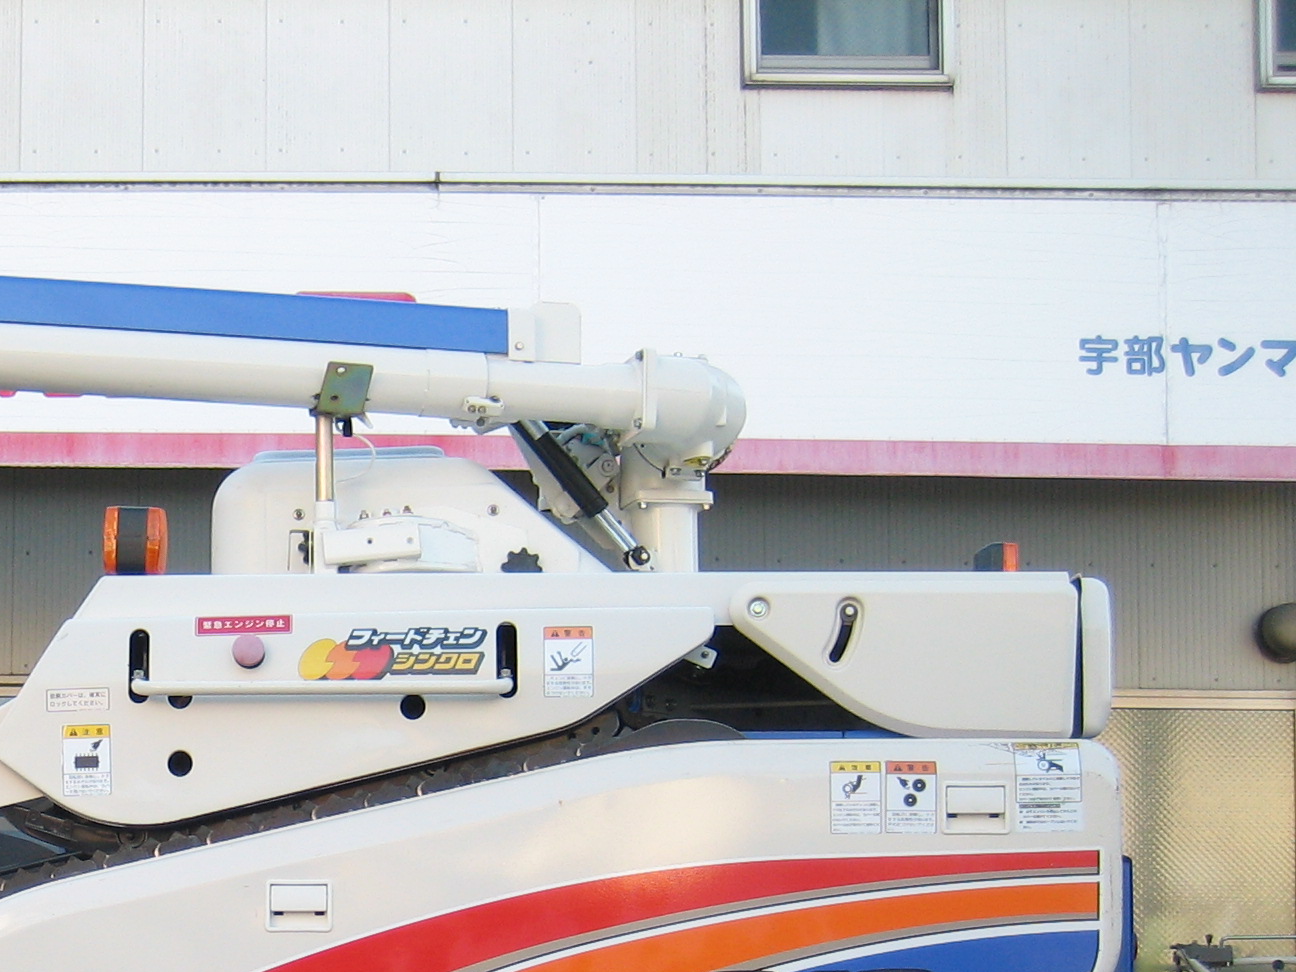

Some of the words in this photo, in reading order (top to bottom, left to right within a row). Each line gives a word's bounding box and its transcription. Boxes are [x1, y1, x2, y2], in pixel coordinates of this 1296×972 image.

[202, 618, 287, 630] 緊急エンジン停止
